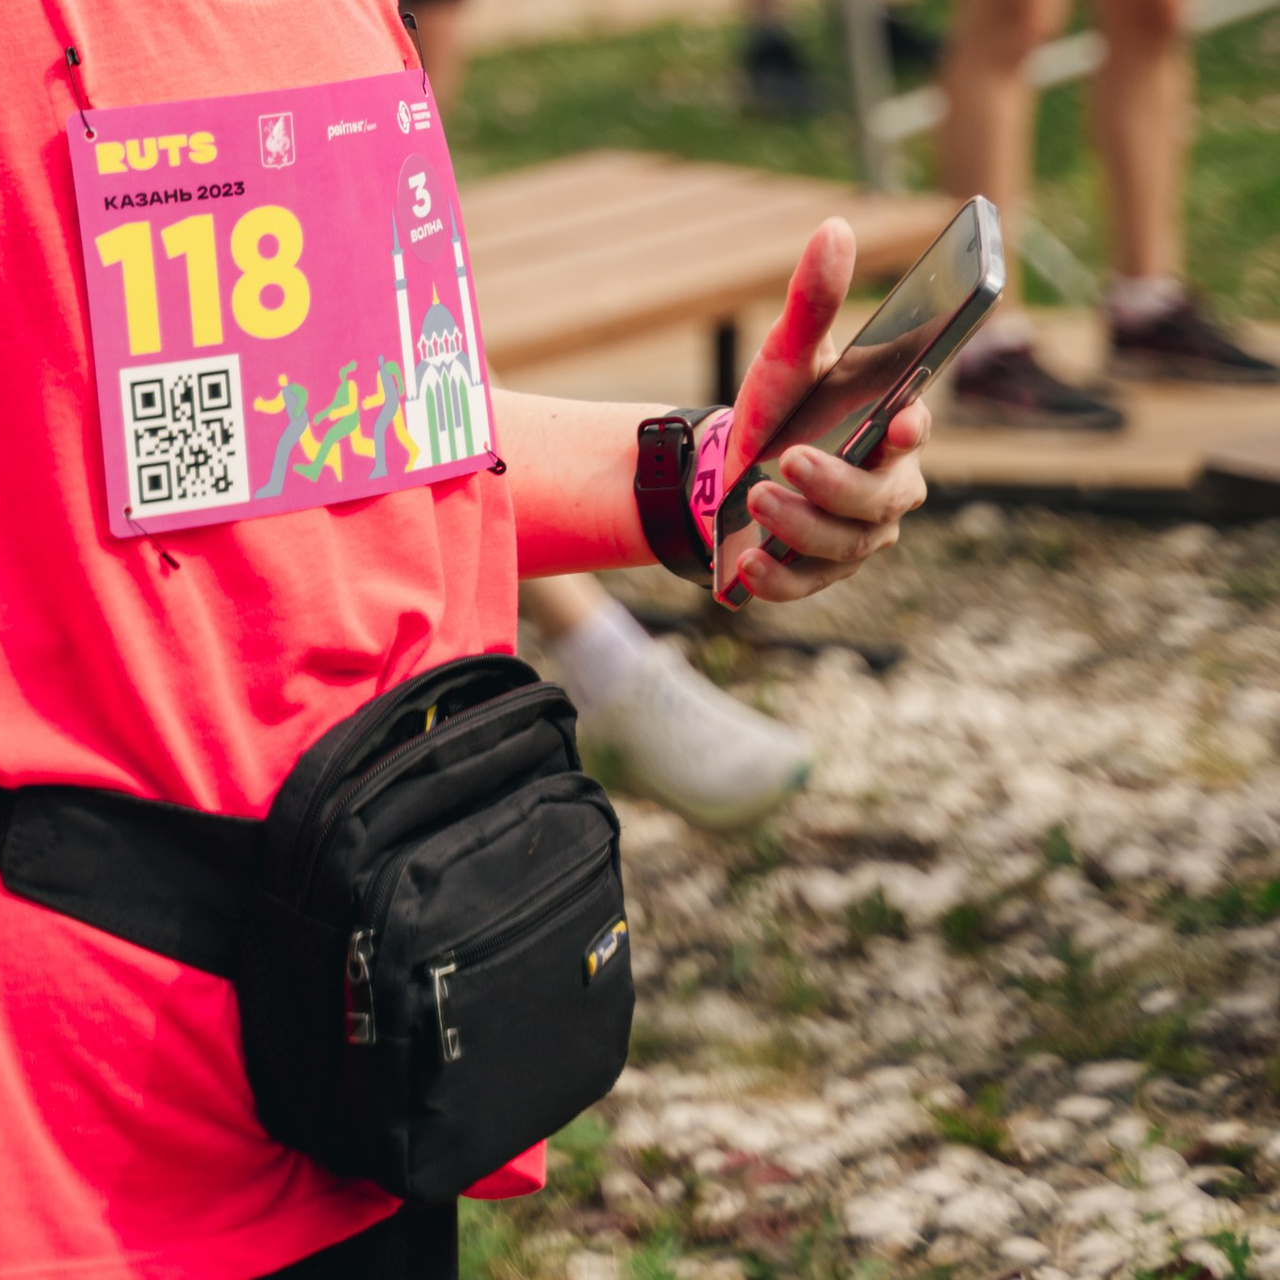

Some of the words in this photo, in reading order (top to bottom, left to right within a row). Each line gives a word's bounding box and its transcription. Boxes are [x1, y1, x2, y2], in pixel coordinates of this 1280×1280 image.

[95, 131, 217, 175] RUTS
[104, 188, 193, 211] КАЗАНЬ
[197, 181, 246, 200] 2023
[408, 171, 432, 218] 3
[410, 218, 444, 244] ВОЛНА
[95, 205, 311, 356] 118
